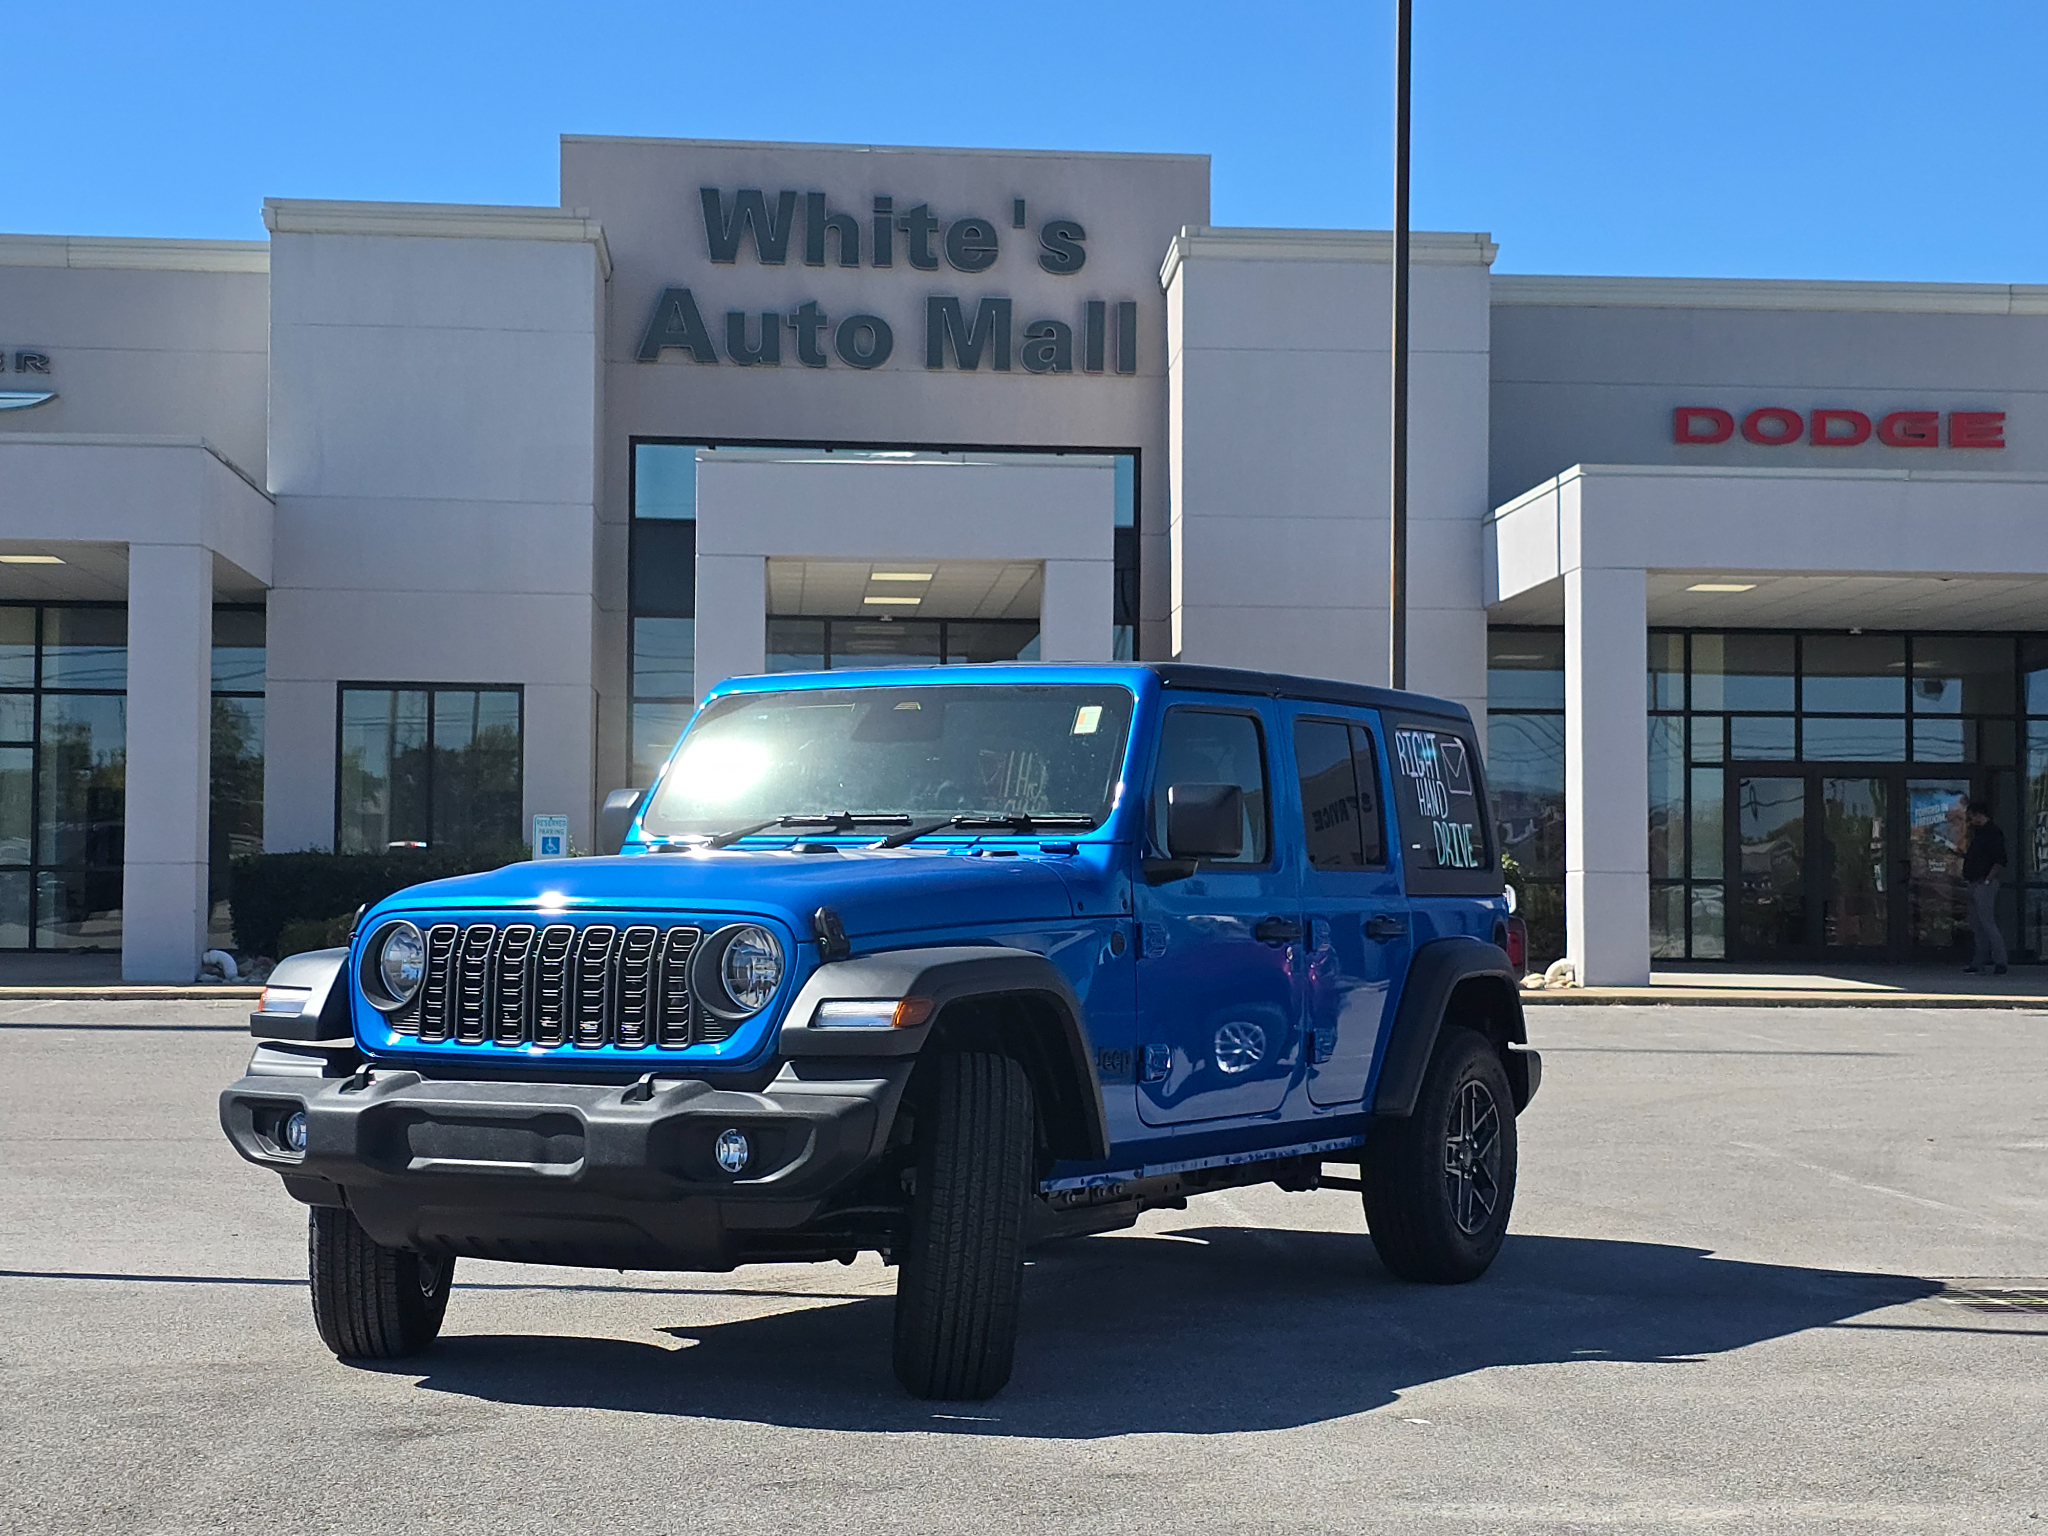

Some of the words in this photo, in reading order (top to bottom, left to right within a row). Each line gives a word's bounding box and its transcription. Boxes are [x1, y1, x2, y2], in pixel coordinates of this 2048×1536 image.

[700, 187, 1086, 275] White's
[636, 287, 894, 369] Auto
[925, 296, 1137, 374] Mall
[0, 351, 50, 374] R
[1674, 407, 2006, 448] DODGE
[1395, 731, 1440, 780] RIGHT
[1416, 777, 1448, 819] HAND
[1433, 820, 1478, 868] DRIVE
[1097, 1046, 1130, 1075] Jeep
